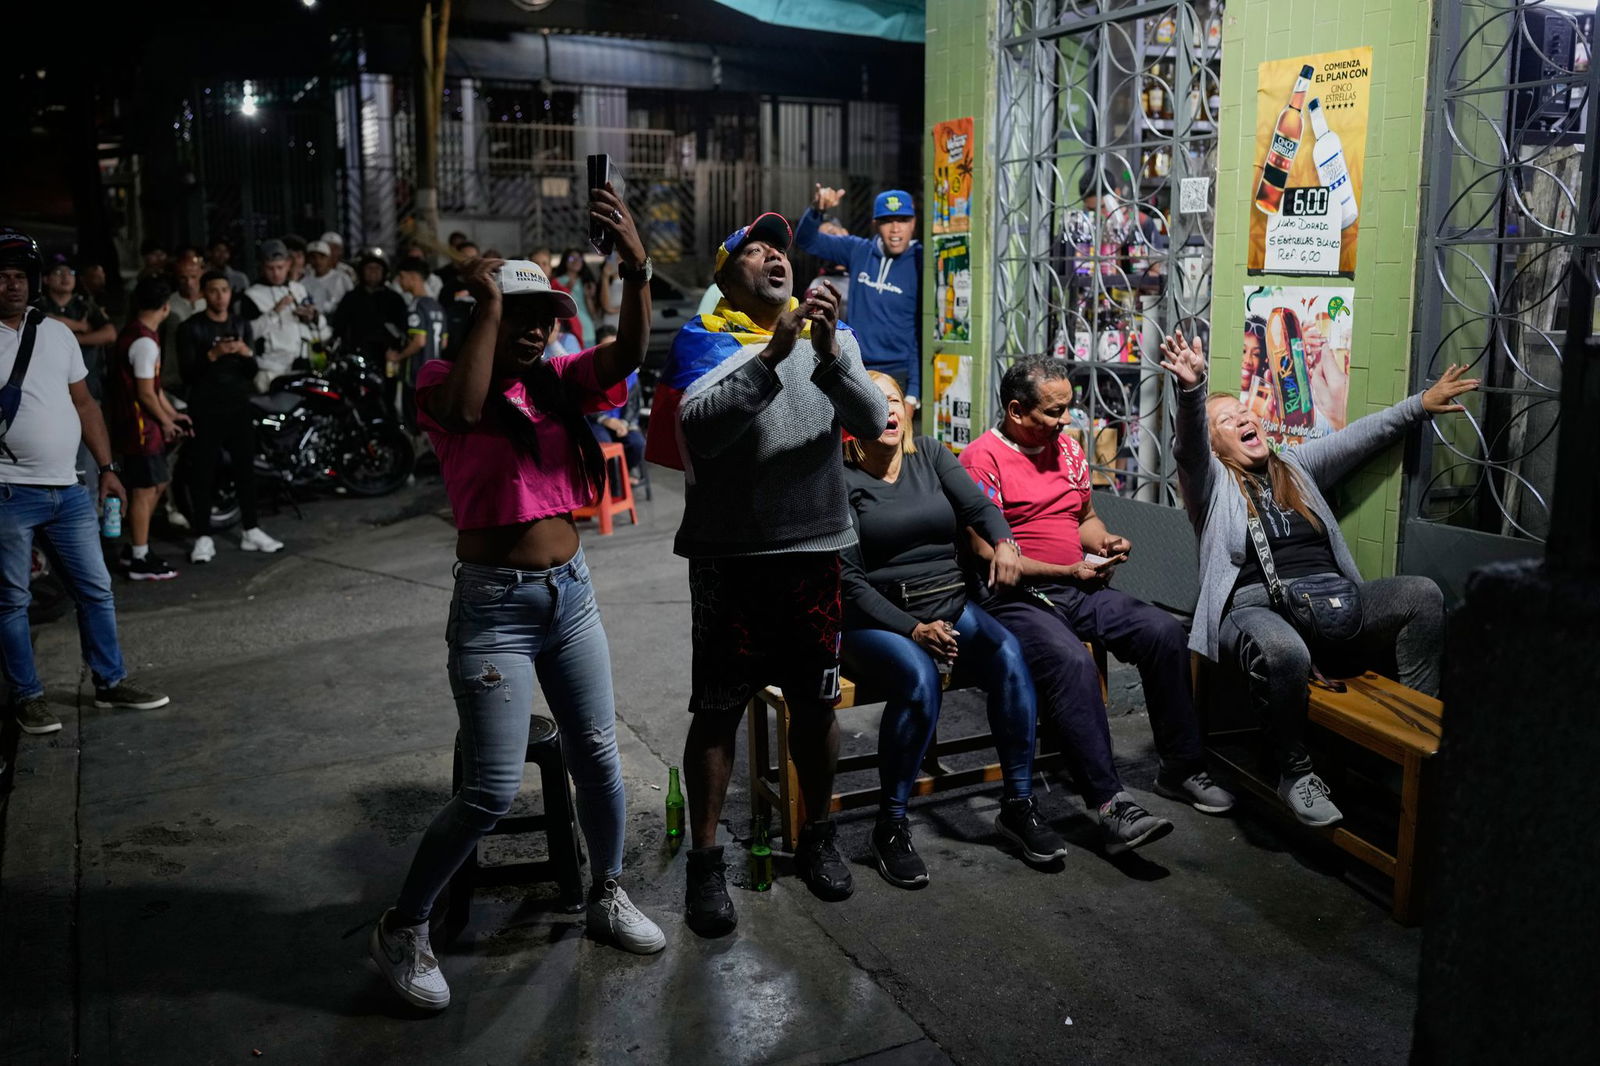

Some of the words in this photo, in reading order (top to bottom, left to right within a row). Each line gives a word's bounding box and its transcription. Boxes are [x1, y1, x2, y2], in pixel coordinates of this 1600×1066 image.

[1324, 60, 1361, 71] COMIENZA
[1315, 74, 1325, 83] EL
[1326, 71, 1348, 82] PLAN
[1349, 68, 1368, 79] CON
[1331, 82, 1353, 93] CINCO
[1325, 91, 1357, 103] ESTRELLAS
